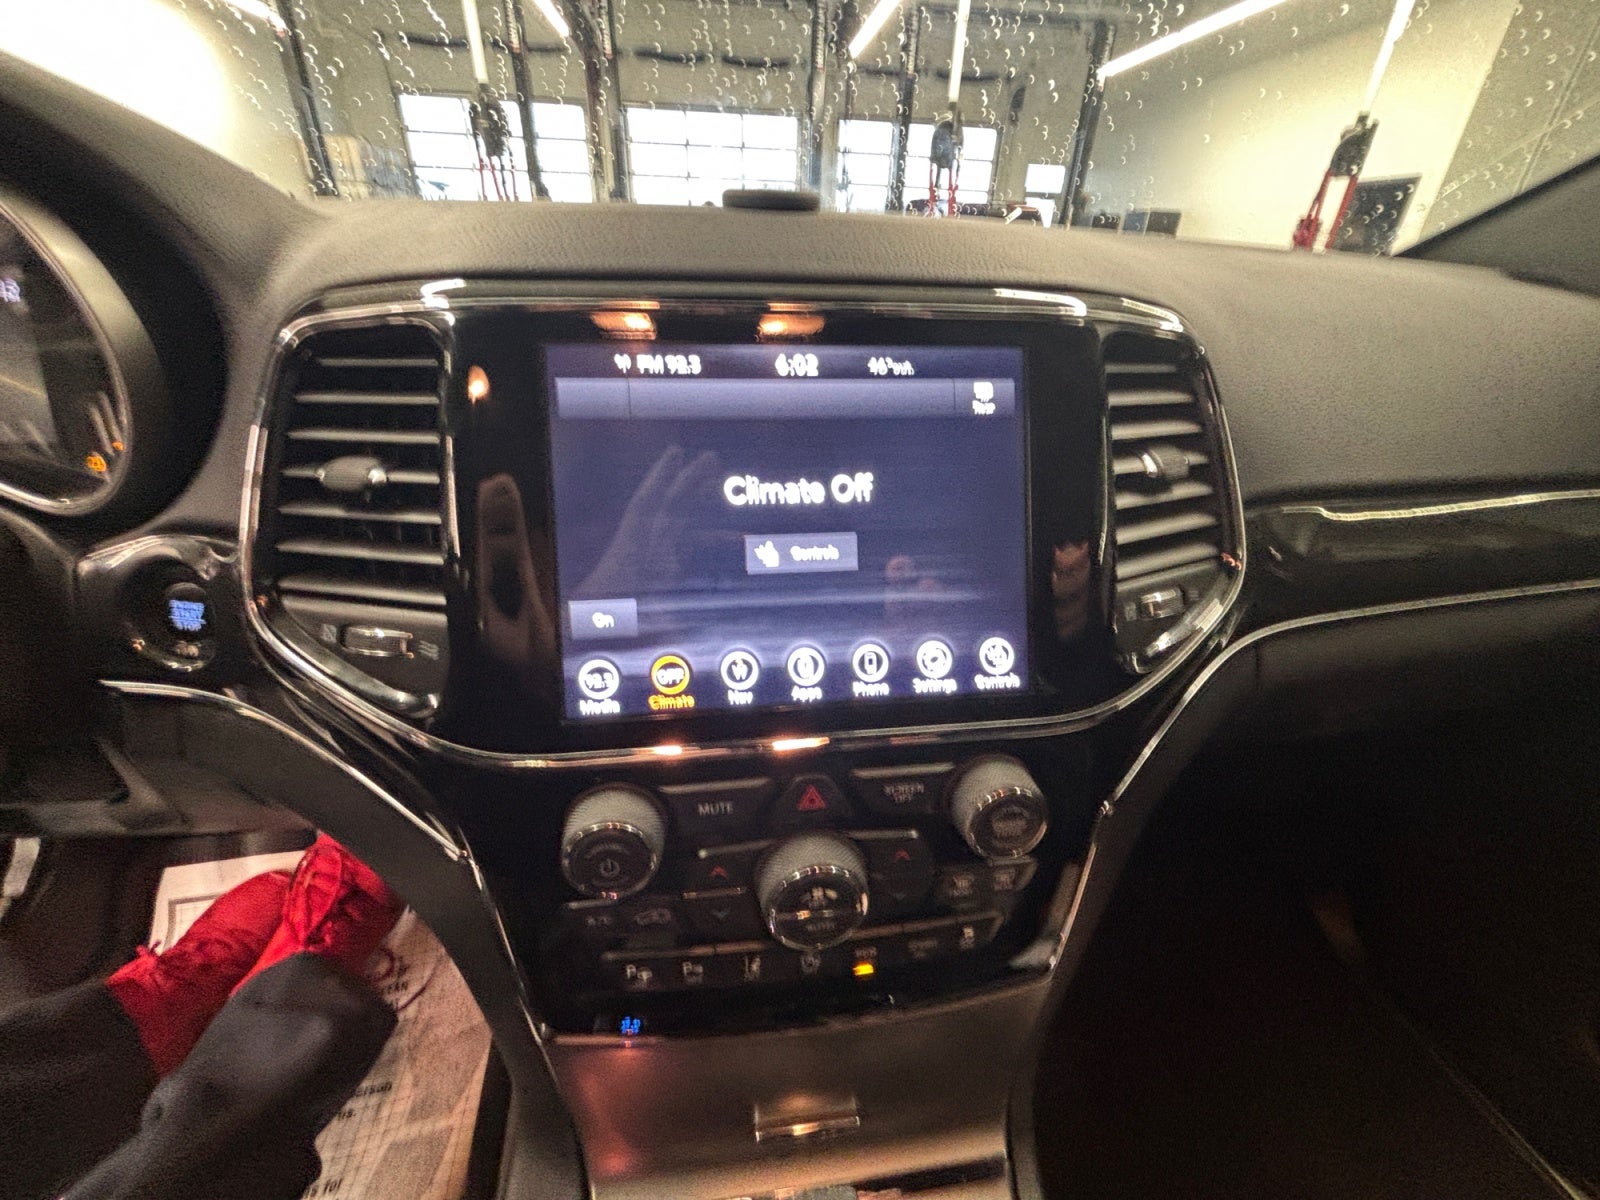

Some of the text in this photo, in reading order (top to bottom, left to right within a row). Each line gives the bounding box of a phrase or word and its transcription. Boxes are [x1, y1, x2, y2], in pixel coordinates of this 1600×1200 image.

[636, 354, 702, 375] FM 92.3
[774, 353, 819, 377] 6:02
[723, 472, 874, 506] Climate Off
[592, 612, 615, 628] On
[656, 667, 685, 685] OFF
[974, 673, 1021, 690] Controls
[791, 686, 822, 702] Apps
[852, 681, 889, 697] Phone
[912, 677, 957, 694] Settings
[648, 694, 695, 711] Climate
[728, 690, 753, 705] Nav
[698, 801, 733, 816] MUTE
